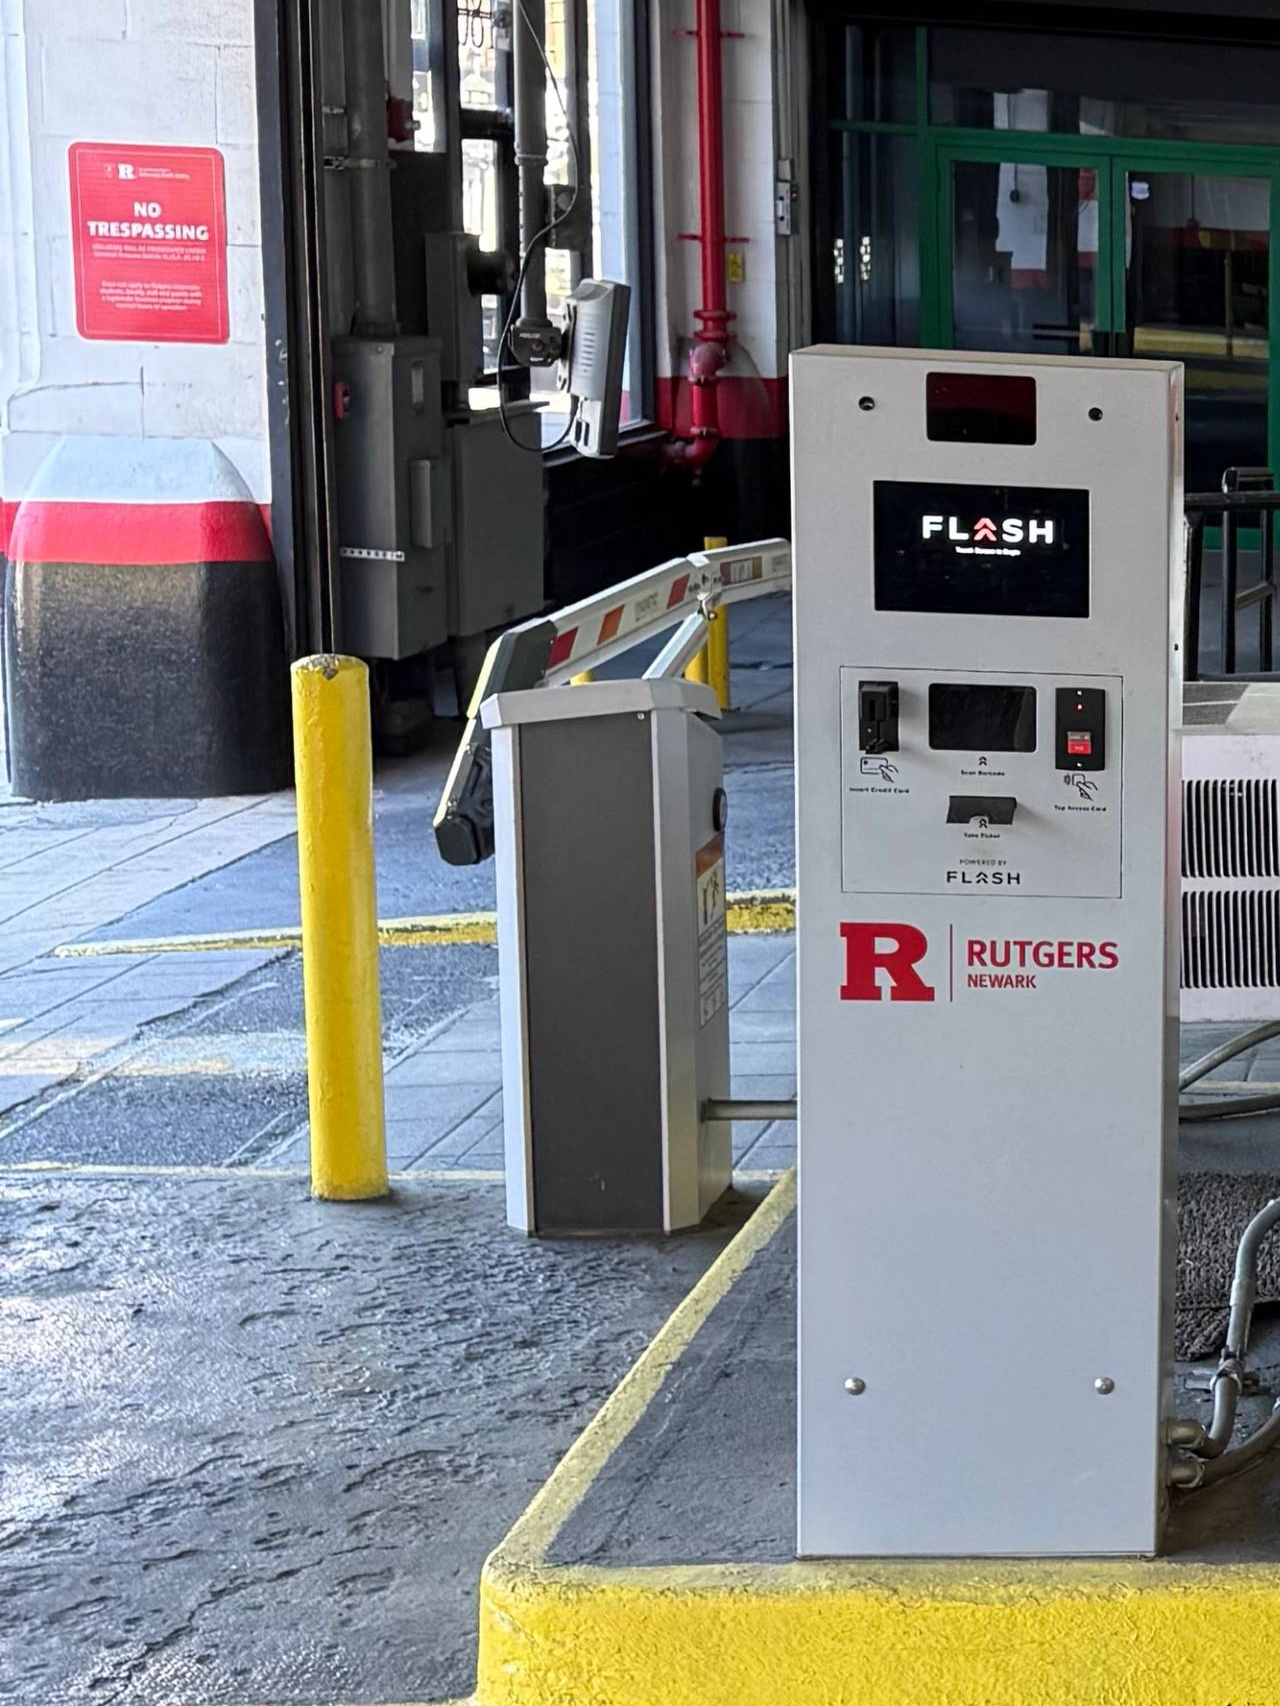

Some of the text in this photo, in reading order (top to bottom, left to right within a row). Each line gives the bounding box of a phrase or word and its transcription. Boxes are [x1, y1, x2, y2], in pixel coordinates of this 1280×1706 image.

[118, 164, 136, 179] R
[133, 201, 161, 218] NO
[87, 221, 209, 241] TRESPASSING
[840, 922, 935, 1001] R
[967, 940, 1119, 969] RUTGERS
[967, 974, 1036, 989] NEWARK
